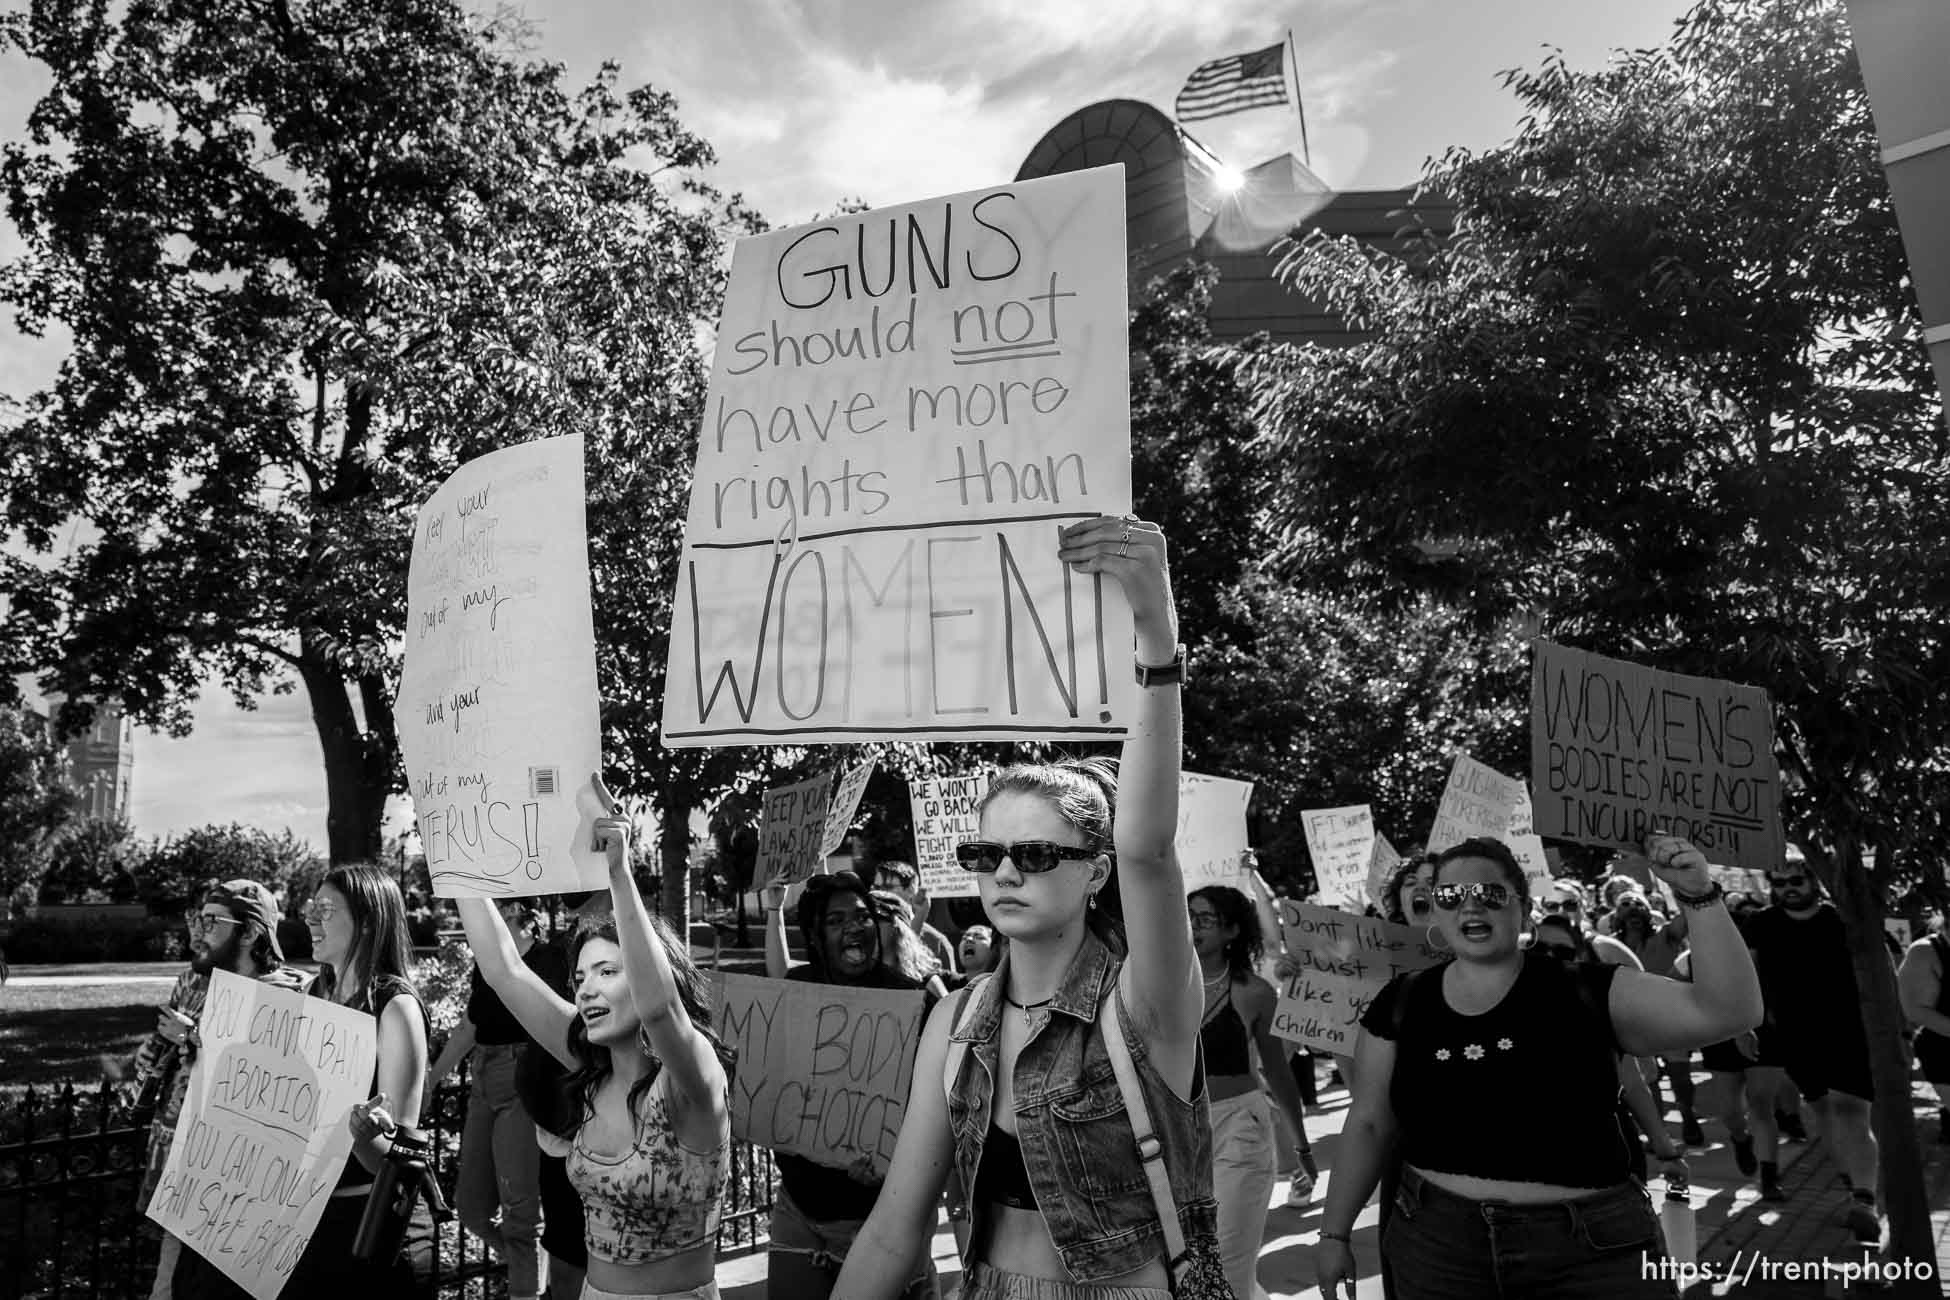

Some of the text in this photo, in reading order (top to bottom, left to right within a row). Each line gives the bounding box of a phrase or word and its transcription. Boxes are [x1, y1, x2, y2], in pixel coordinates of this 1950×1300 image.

[777, 192, 1021, 309] GUNS
[727, 272, 1077, 375] should not
[717, 377, 1069, 453] have more
[714, 439, 1088, 561] rights than
[462, 584, 512, 632] my
[689, 525, 1113, 724] WOMEN!
[449, 686, 481, 734] your
[1542, 655, 1756, 769] WOMEN'S
[457, 771, 493, 805] my
[911, 777, 980, 800] WE WON'T
[924, 796, 976, 817] GO BACK
[1548, 741, 1652, 801] BODIES
[1658, 765, 1705, 811] ARE
[1711, 771, 1769, 818] NOT
[421, 800, 543, 882] TERUS!
[914, 816, 977, 835] WE WILL
[917, 835, 953, 854] FIGHT
[721, 988, 919, 1093] MY BODY
[1275, 1013, 1345, 1043] Children
[1343, 991, 1373, 1026] yo
[212, 1054, 329, 1133] ABORTION
[739, 1072, 902, 1163] Y CHOICE
